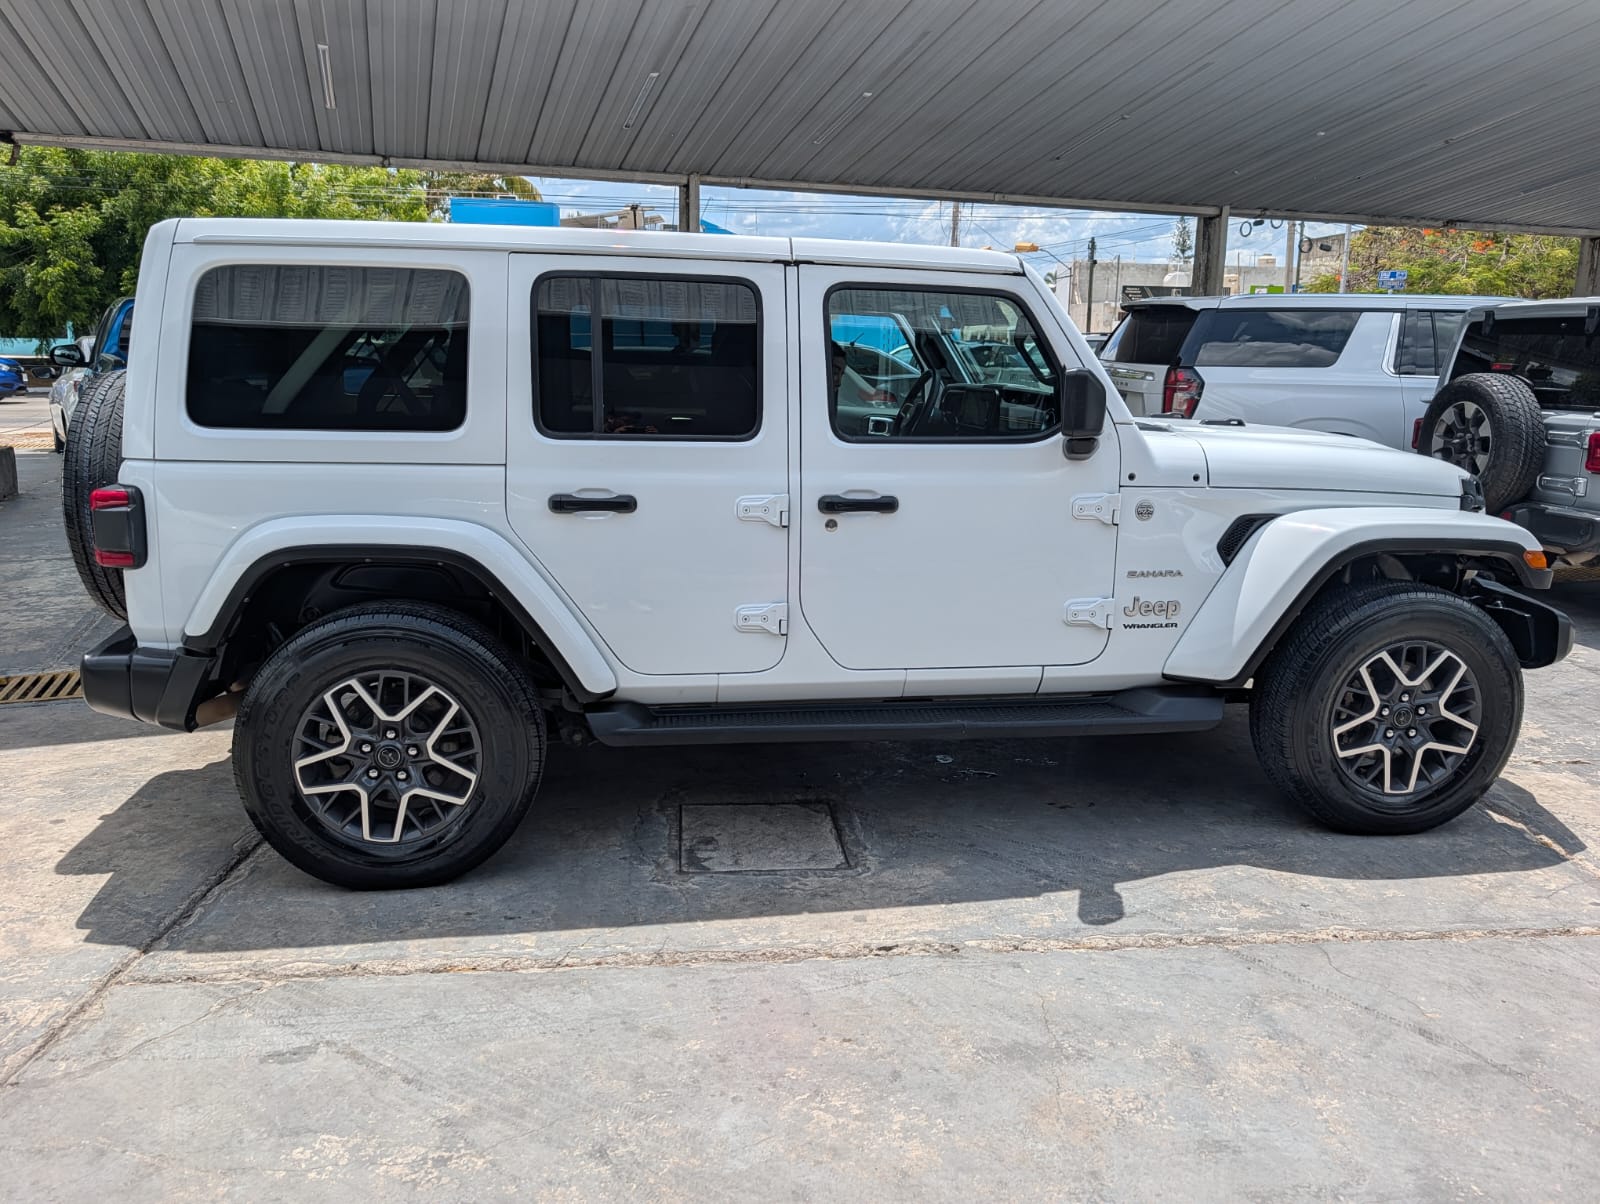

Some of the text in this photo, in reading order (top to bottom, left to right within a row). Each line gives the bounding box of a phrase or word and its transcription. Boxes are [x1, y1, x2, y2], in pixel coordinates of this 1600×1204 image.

[1127, 570, 1183, 579] SAHARA
[1123, 596, 1181, 620] Jeep
[1122, 622, 1178, 630] WRANGLER
